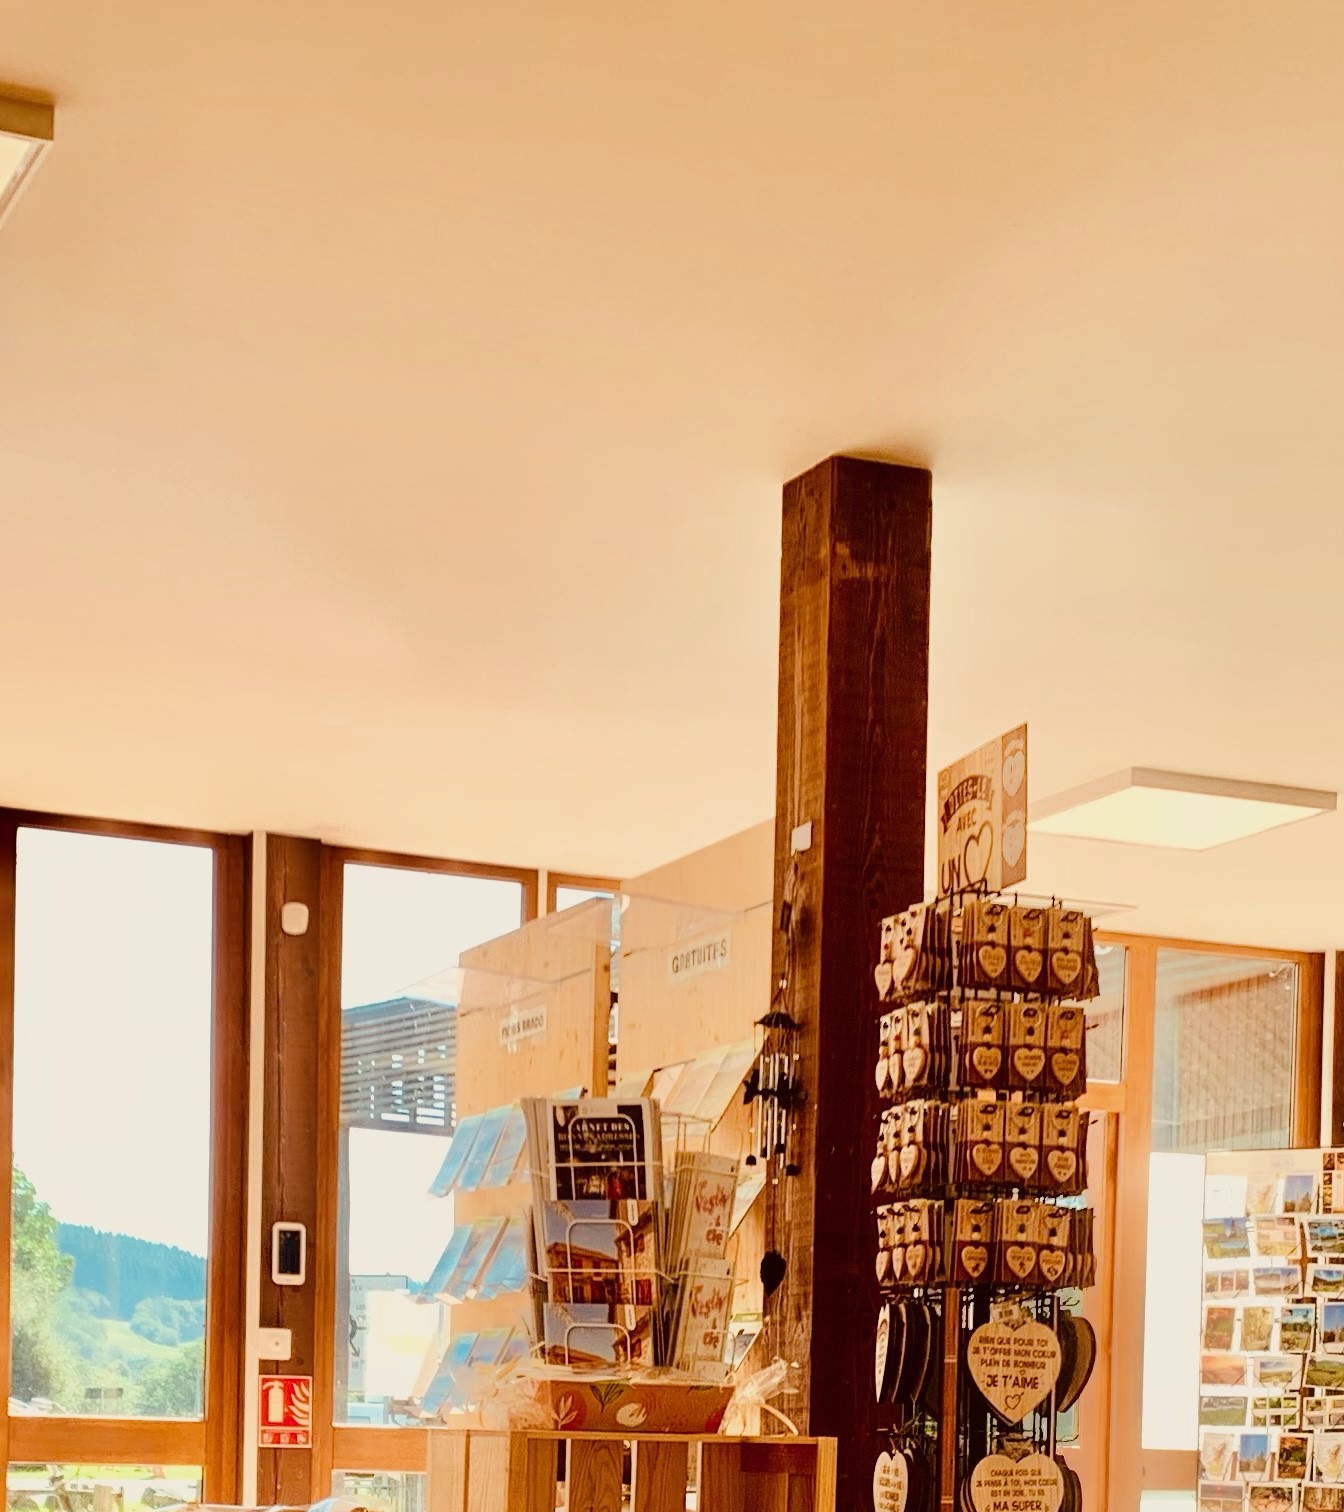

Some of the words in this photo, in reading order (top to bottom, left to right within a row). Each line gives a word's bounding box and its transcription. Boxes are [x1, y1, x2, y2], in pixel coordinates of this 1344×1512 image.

[957, 807, 977, 831] AVEC
[942, 854, 961, 894] UN
[997, 1337, 1011, 1346] QUE
[1013, 1338, 1034, 1347] POUR
[1036, 1338, 1049, 1347] TOI
[972, 1346, 980, 1355] JE
[1013, 1349, 1031, 1357] MON
[980, 1358, 1000, 1368] PLEIN
[1002, 1359, 1010, 1368] DE
[986, 1374, 998, 1388] JE
[1002, 1375, 1039, 1389] T'AIME
[993, 1501, 1009, 1512] MA
[1011, 1500, 1042, 1511] SUPER
